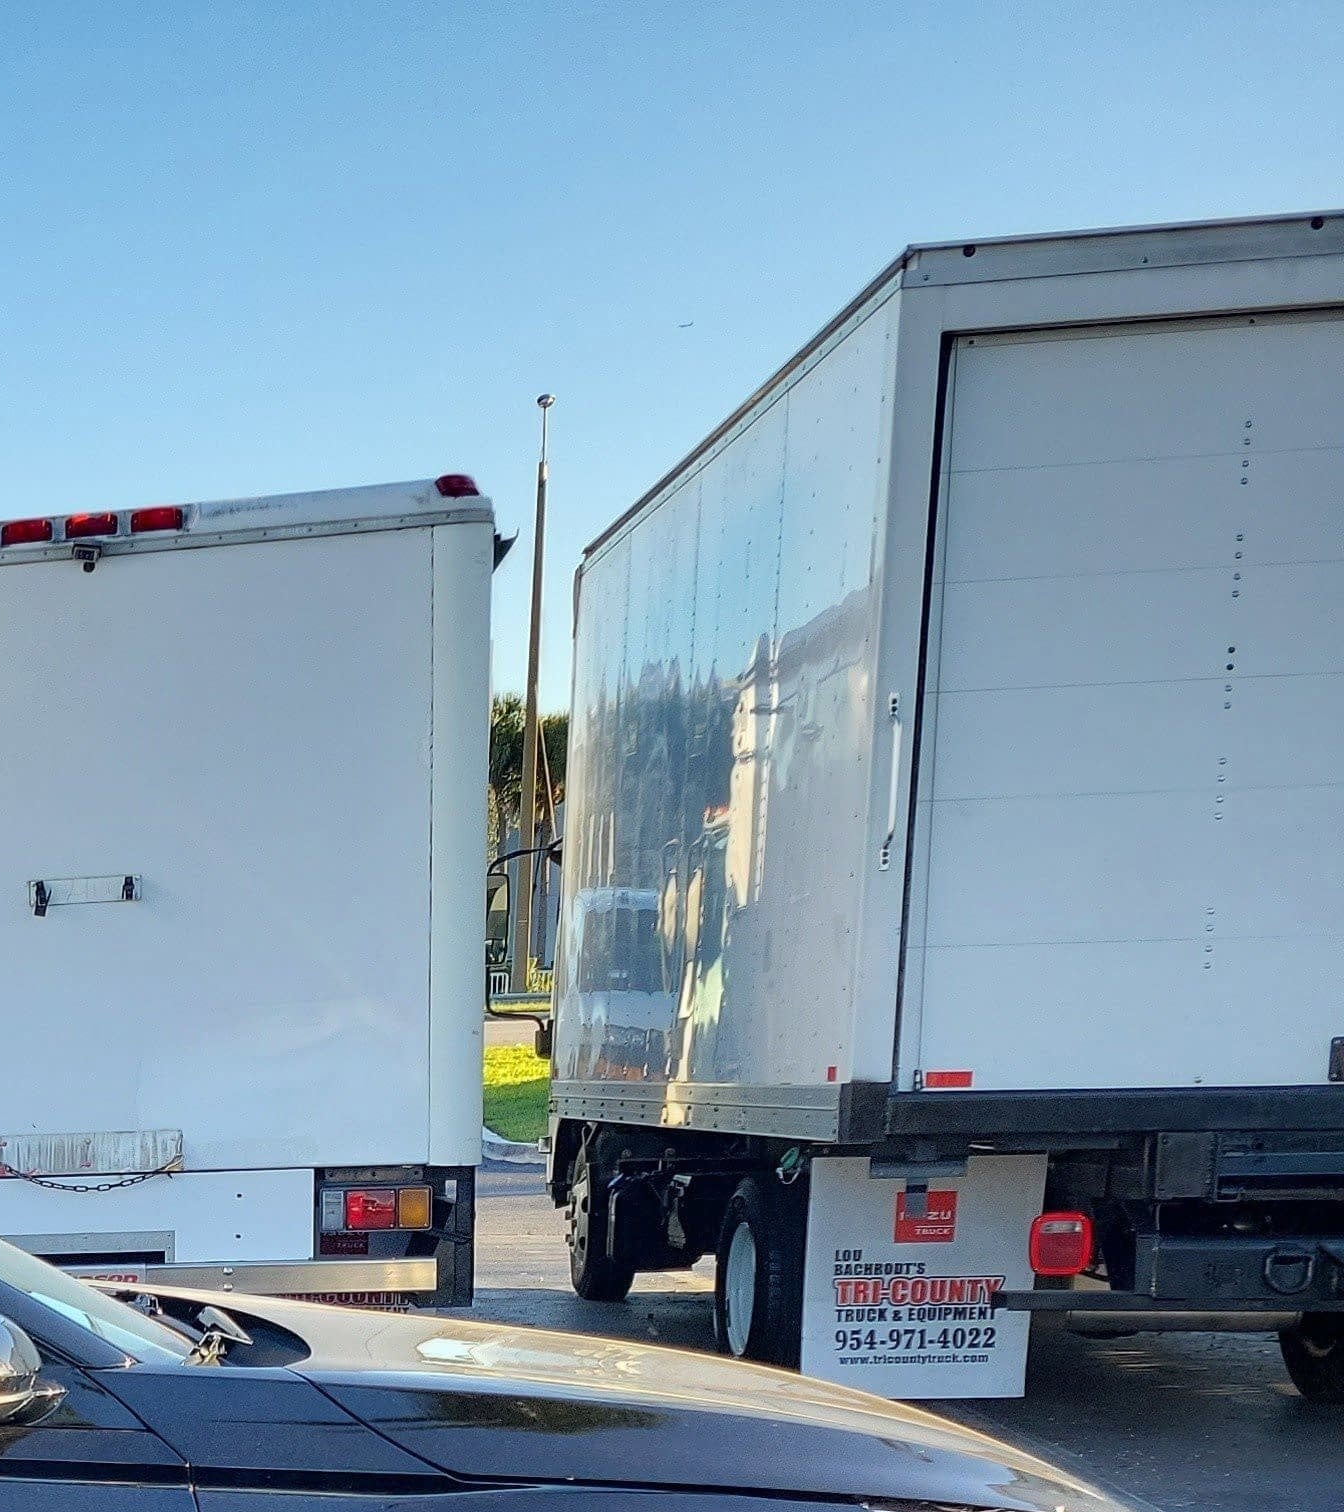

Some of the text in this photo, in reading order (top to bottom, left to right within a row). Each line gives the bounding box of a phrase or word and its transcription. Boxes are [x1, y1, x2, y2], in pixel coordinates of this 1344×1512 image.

[898, 1210, 952, 1221] IZU
[834, 1250, 862, 1262] LOU
[835, 1307, 997, 1322] TRUCK & EQUIPMENT
[834, 1327, 997, 1350] 954-971-4022
[838, 1353, 989, 1365] www.tricountytruck.com
